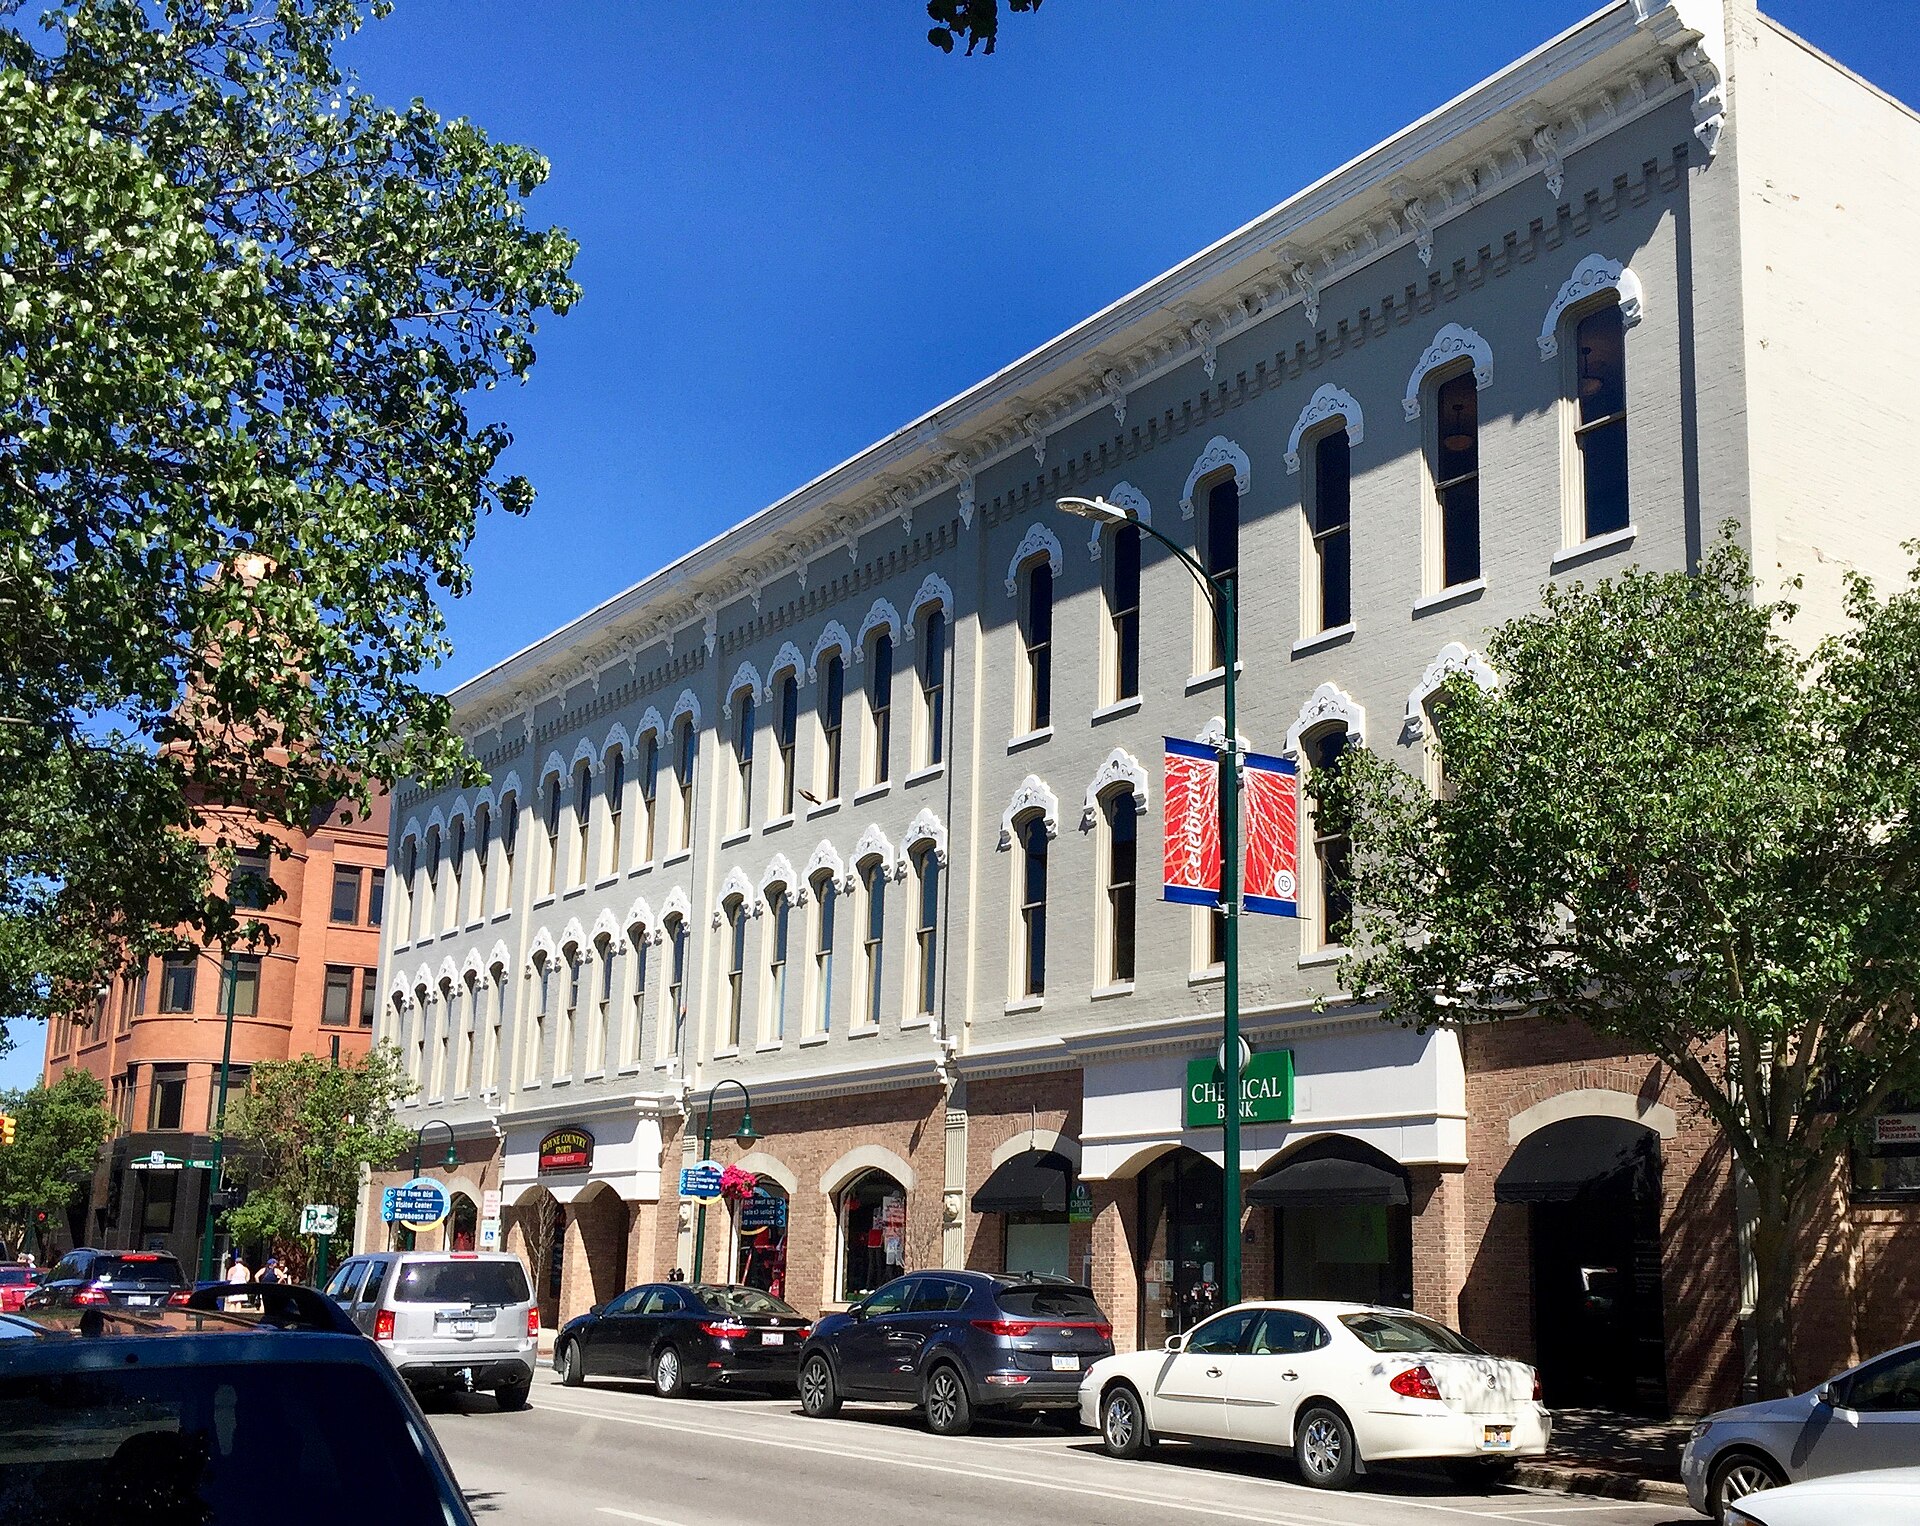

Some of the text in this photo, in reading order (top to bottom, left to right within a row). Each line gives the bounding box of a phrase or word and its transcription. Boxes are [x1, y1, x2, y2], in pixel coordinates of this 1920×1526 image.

[1191, 1077, 1282, 1104] CHEICAL
[1217, 1101, 1254, 1119] BNK
[543, 1134, 587, 1153] BOYNE COUNTRY
[394, 1212, 424, 1220] Warehouse
